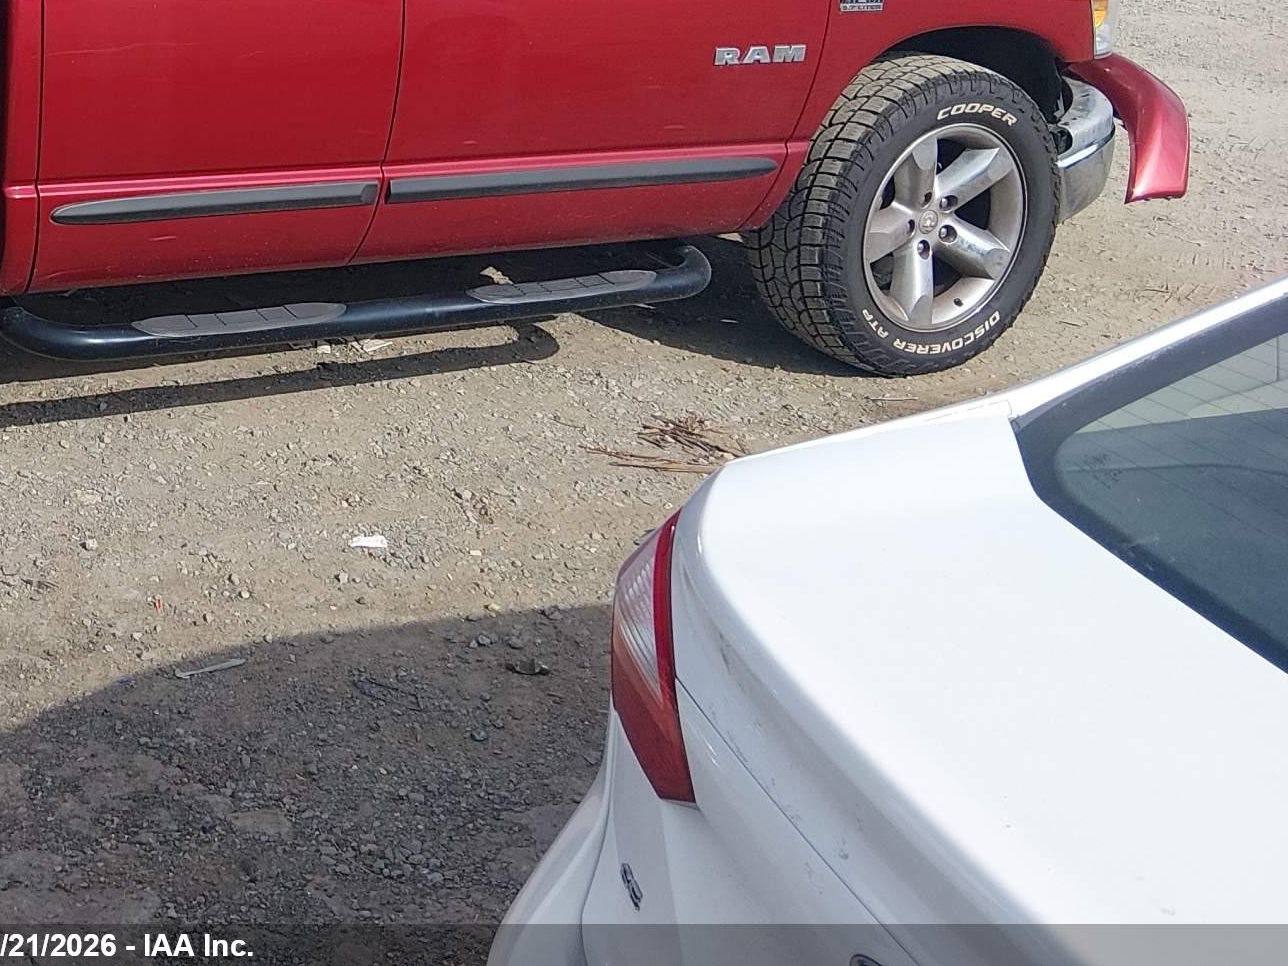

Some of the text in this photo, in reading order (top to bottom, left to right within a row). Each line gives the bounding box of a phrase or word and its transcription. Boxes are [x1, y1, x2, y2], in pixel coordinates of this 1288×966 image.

[714, 44, 807, 66] RAM
[936, 102, 1018, 127] COOPER
[862, 308, 1001, 355] DISCOVERER ATP
